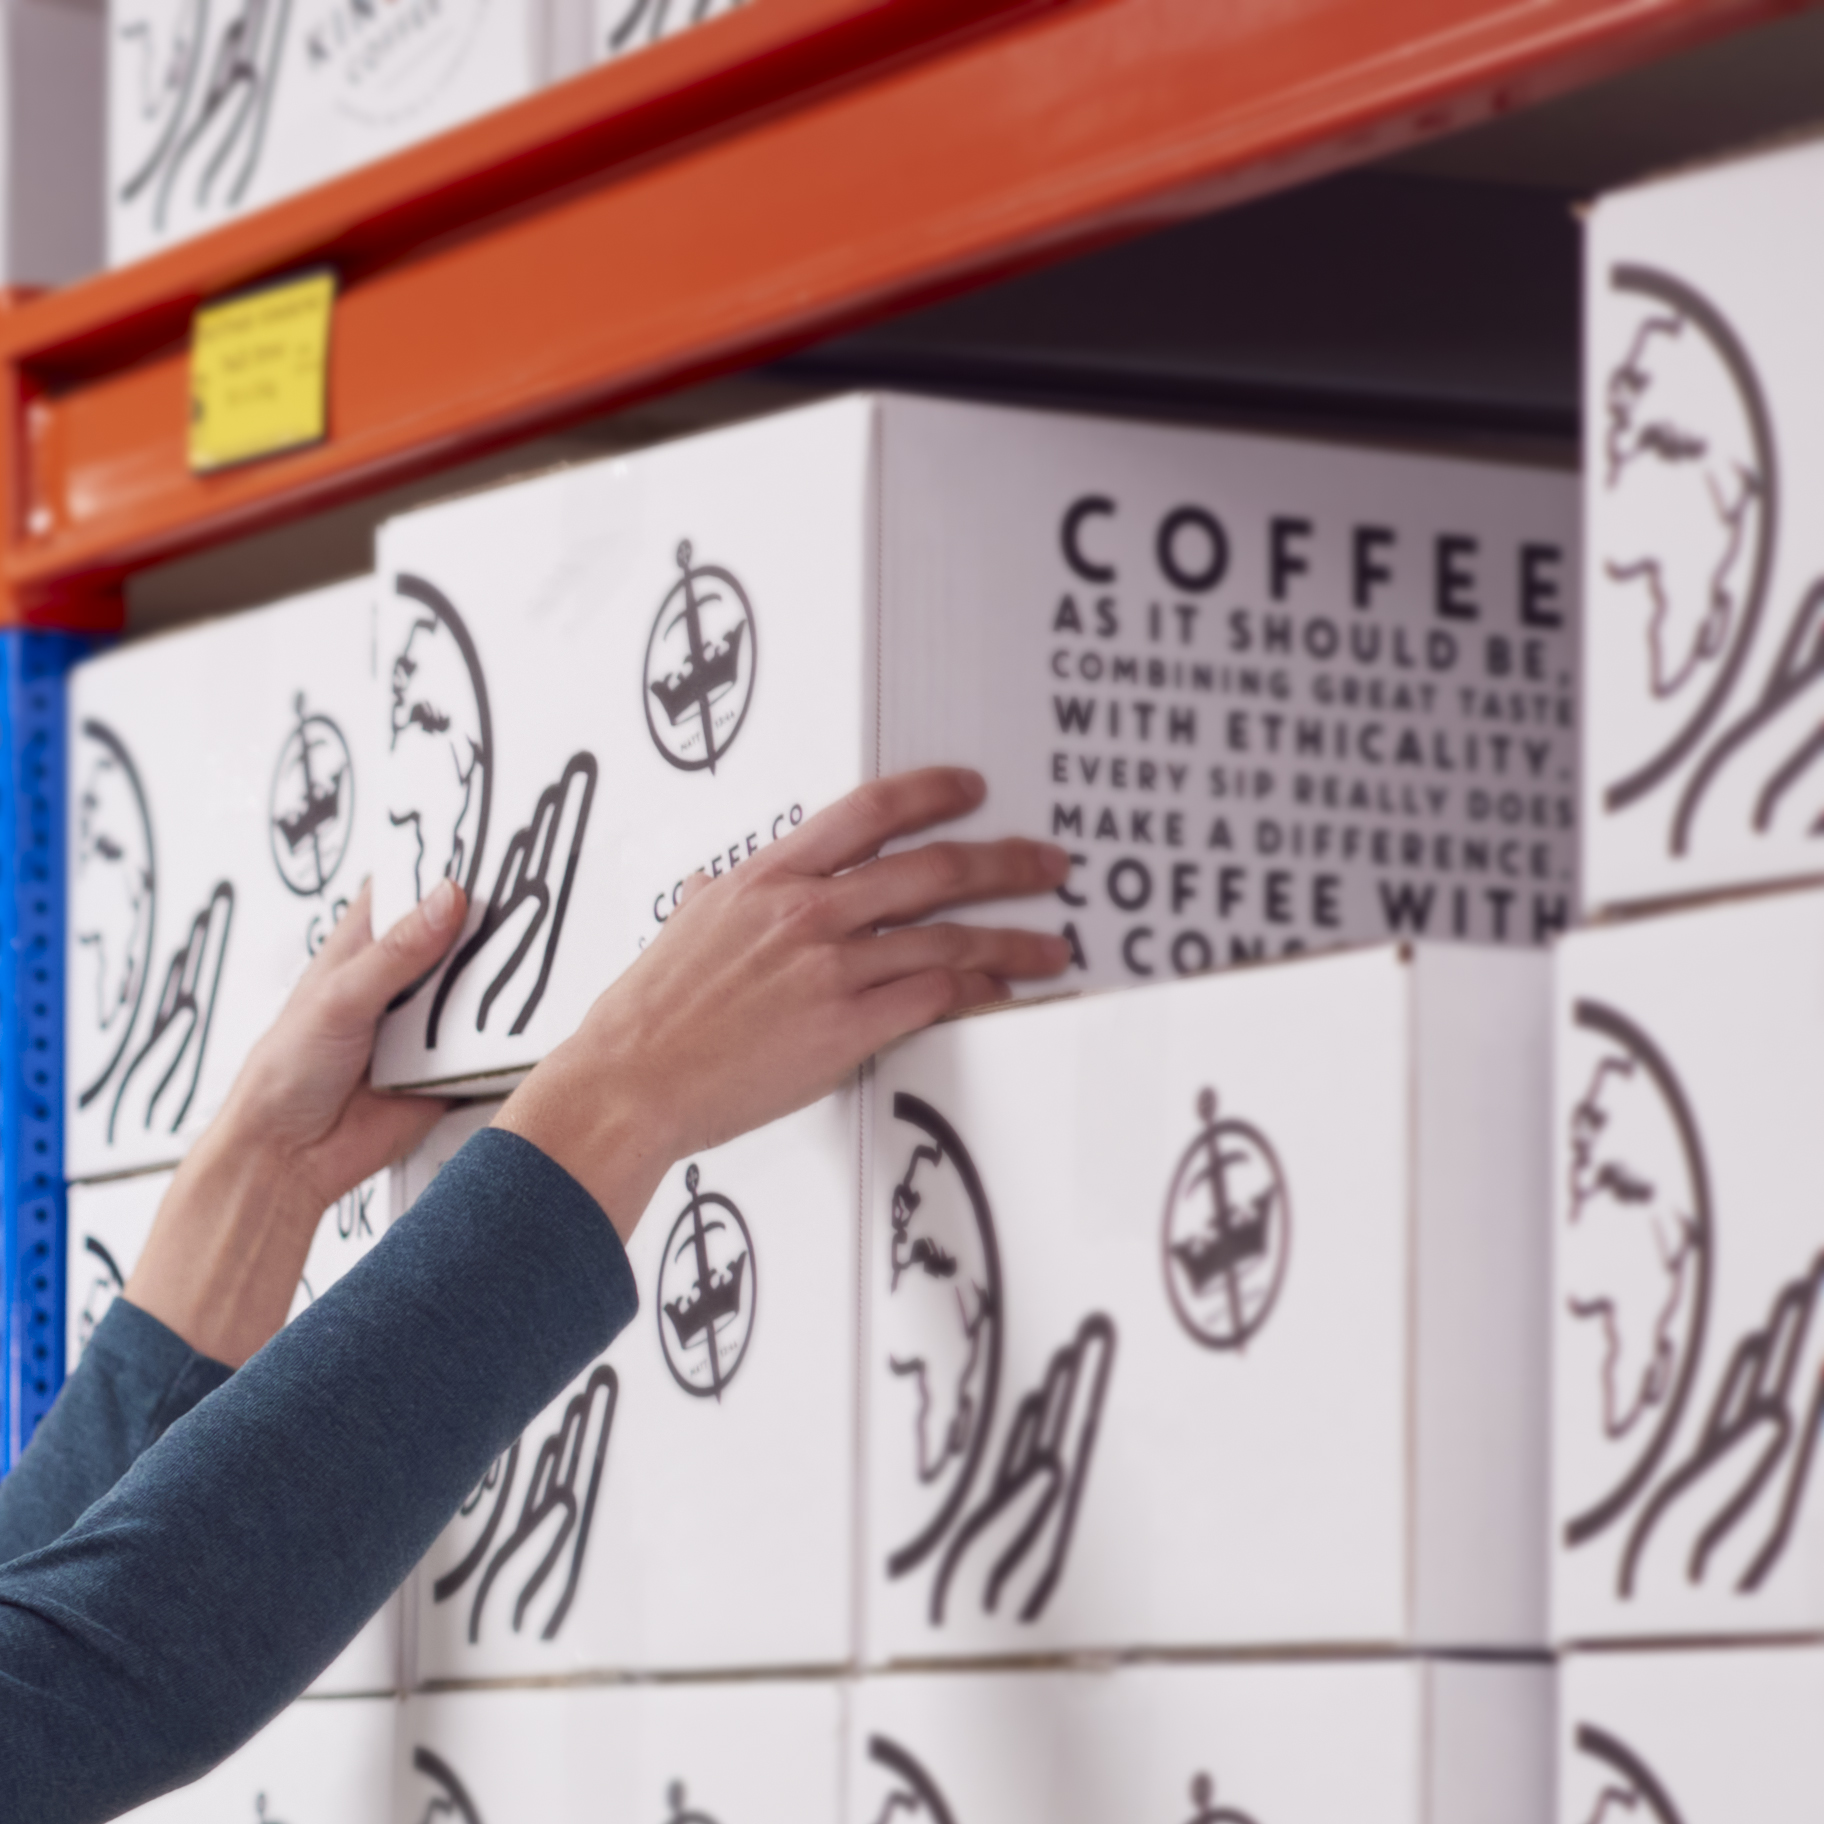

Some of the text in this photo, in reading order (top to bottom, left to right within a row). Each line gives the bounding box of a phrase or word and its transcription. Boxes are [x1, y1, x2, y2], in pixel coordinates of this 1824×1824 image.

[1061, 495, 1565, 628] COFFEE
[1052, 594, 1118, 638] AS
[1149, 601, 1199, 645] IT
[1228, 609, 1457, 672] SHOULD
[1052, 649, 1571, 728] COMBINING GREAT TASTE
[1053, 695, 1196, 745] WITH
[1052, 752, 1574, 830] EVERY SIP REALLY DOES
[1052, 802, 1184, 846] MAKE
[1208, 814, 1233, 850] A
[1056, 853, 1568, 945] COFFEE WITH
[337, 1182, 374, 1240] UK
